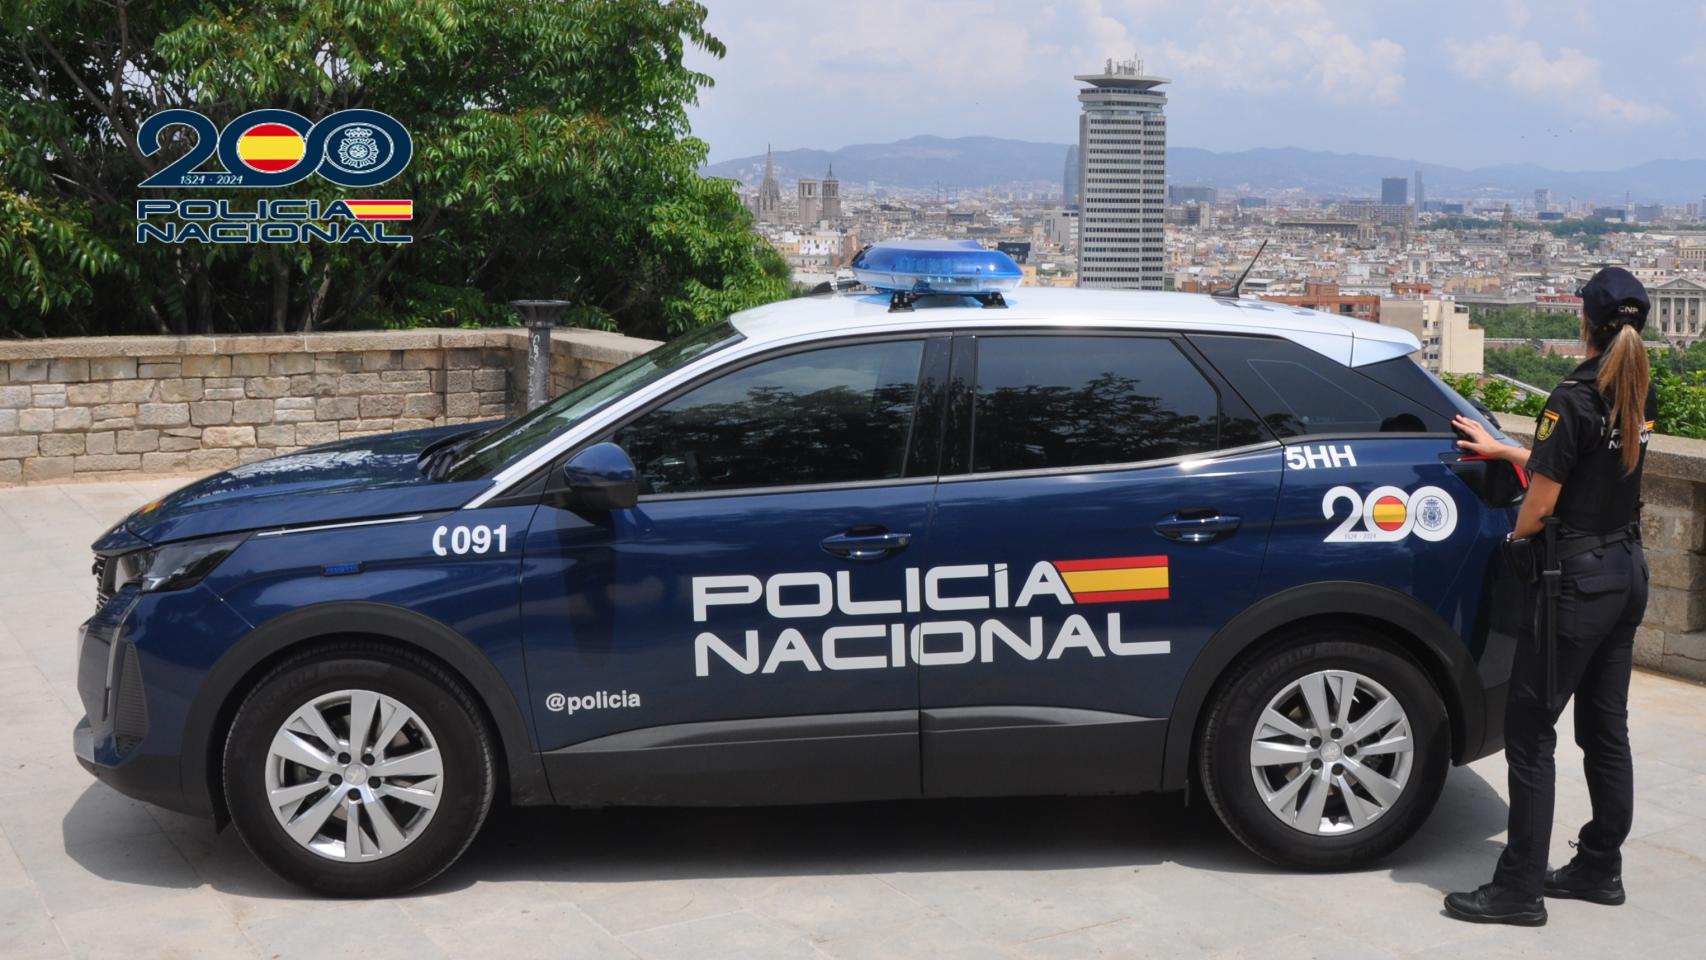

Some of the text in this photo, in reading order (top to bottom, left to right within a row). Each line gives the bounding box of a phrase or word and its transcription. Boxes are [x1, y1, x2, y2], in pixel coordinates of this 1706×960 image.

[1286, 445, 1357, 470] 5HH
[1322, 485, 1458, 542] 200
[451, 524, 507, 555] 091
[694, 612, 1171, 677] NACIONAL
[545, 690, 641, 715] @policia
